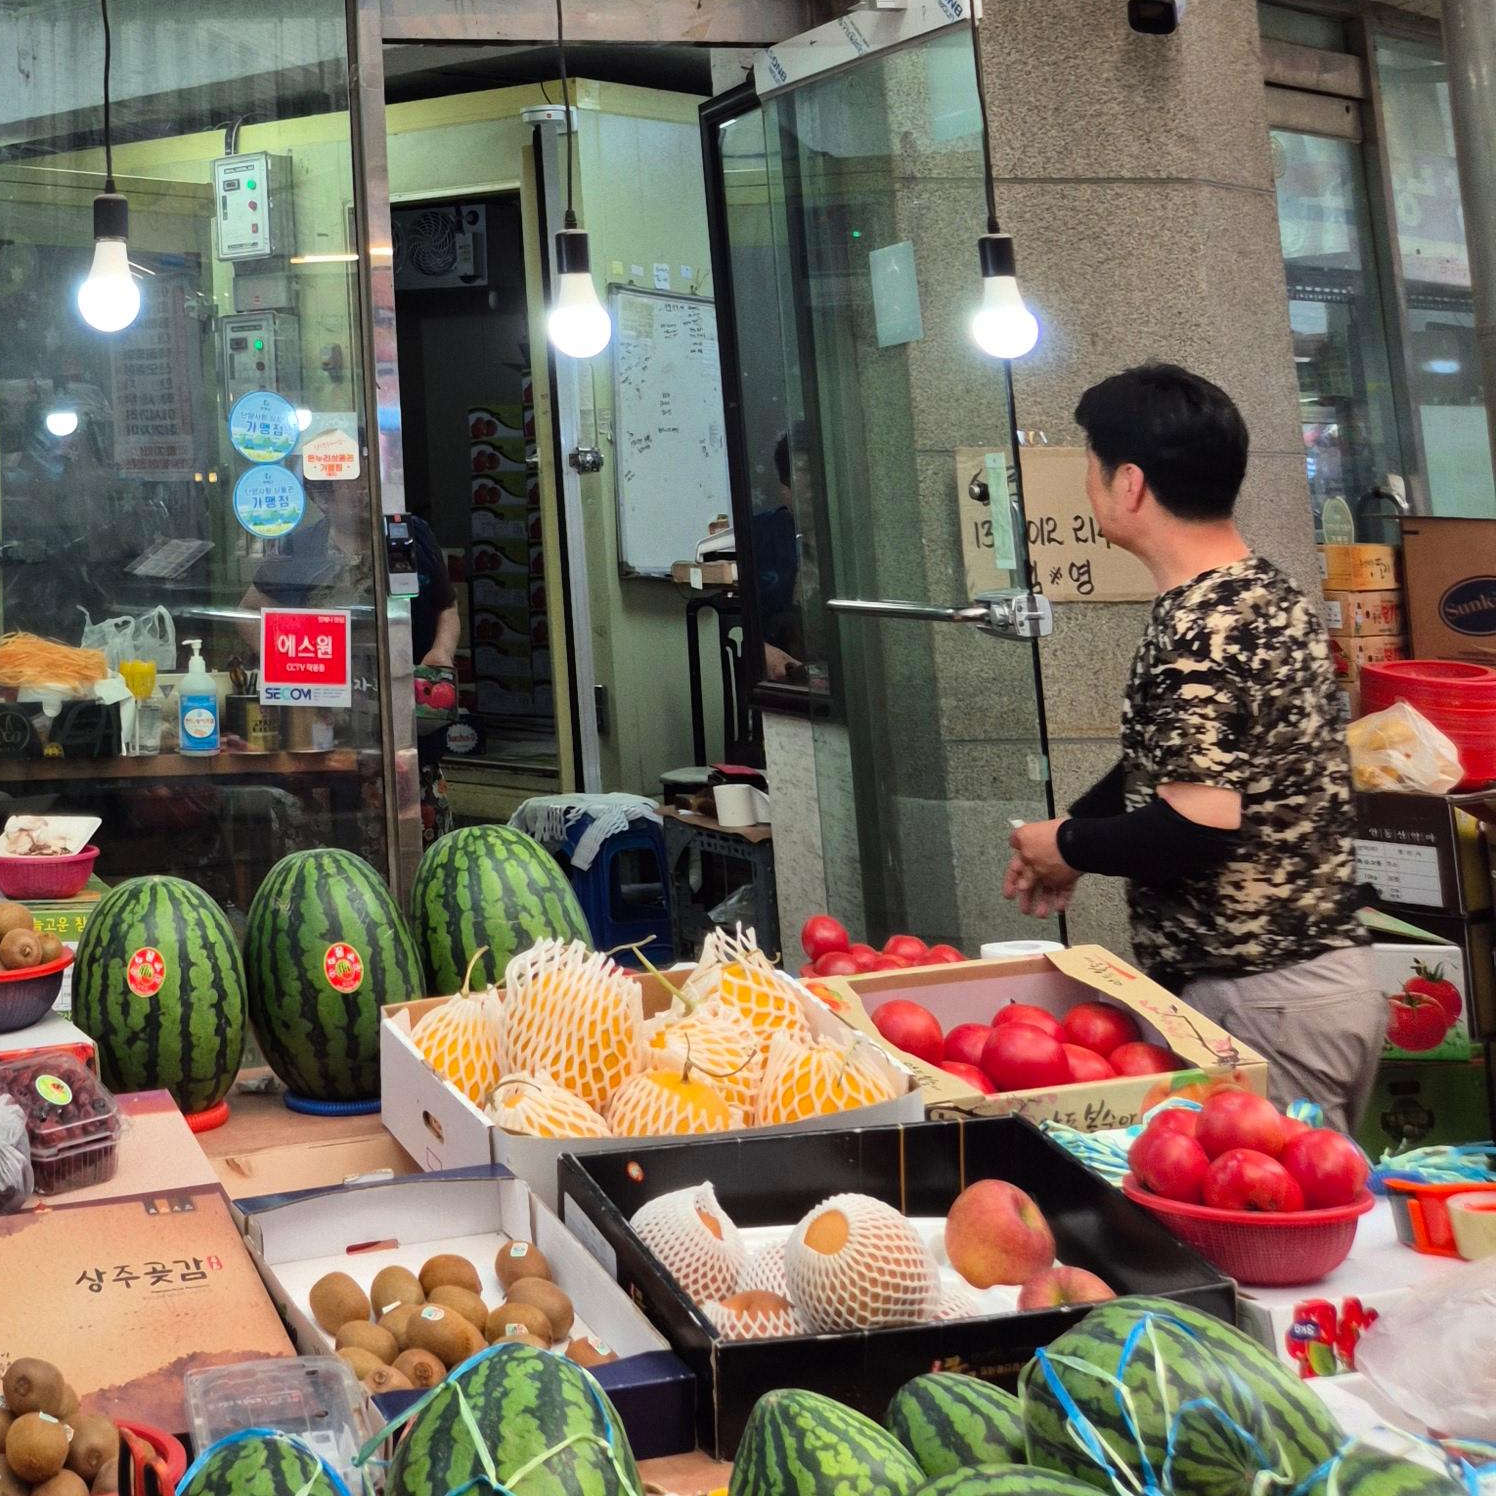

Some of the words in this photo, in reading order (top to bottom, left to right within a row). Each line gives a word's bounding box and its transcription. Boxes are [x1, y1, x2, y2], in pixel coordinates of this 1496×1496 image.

[277, 634, 333, 659] 에스원
[265, 688, 312, 700] SECOM
[76, 1256, 208, 1293] 상주곶감
